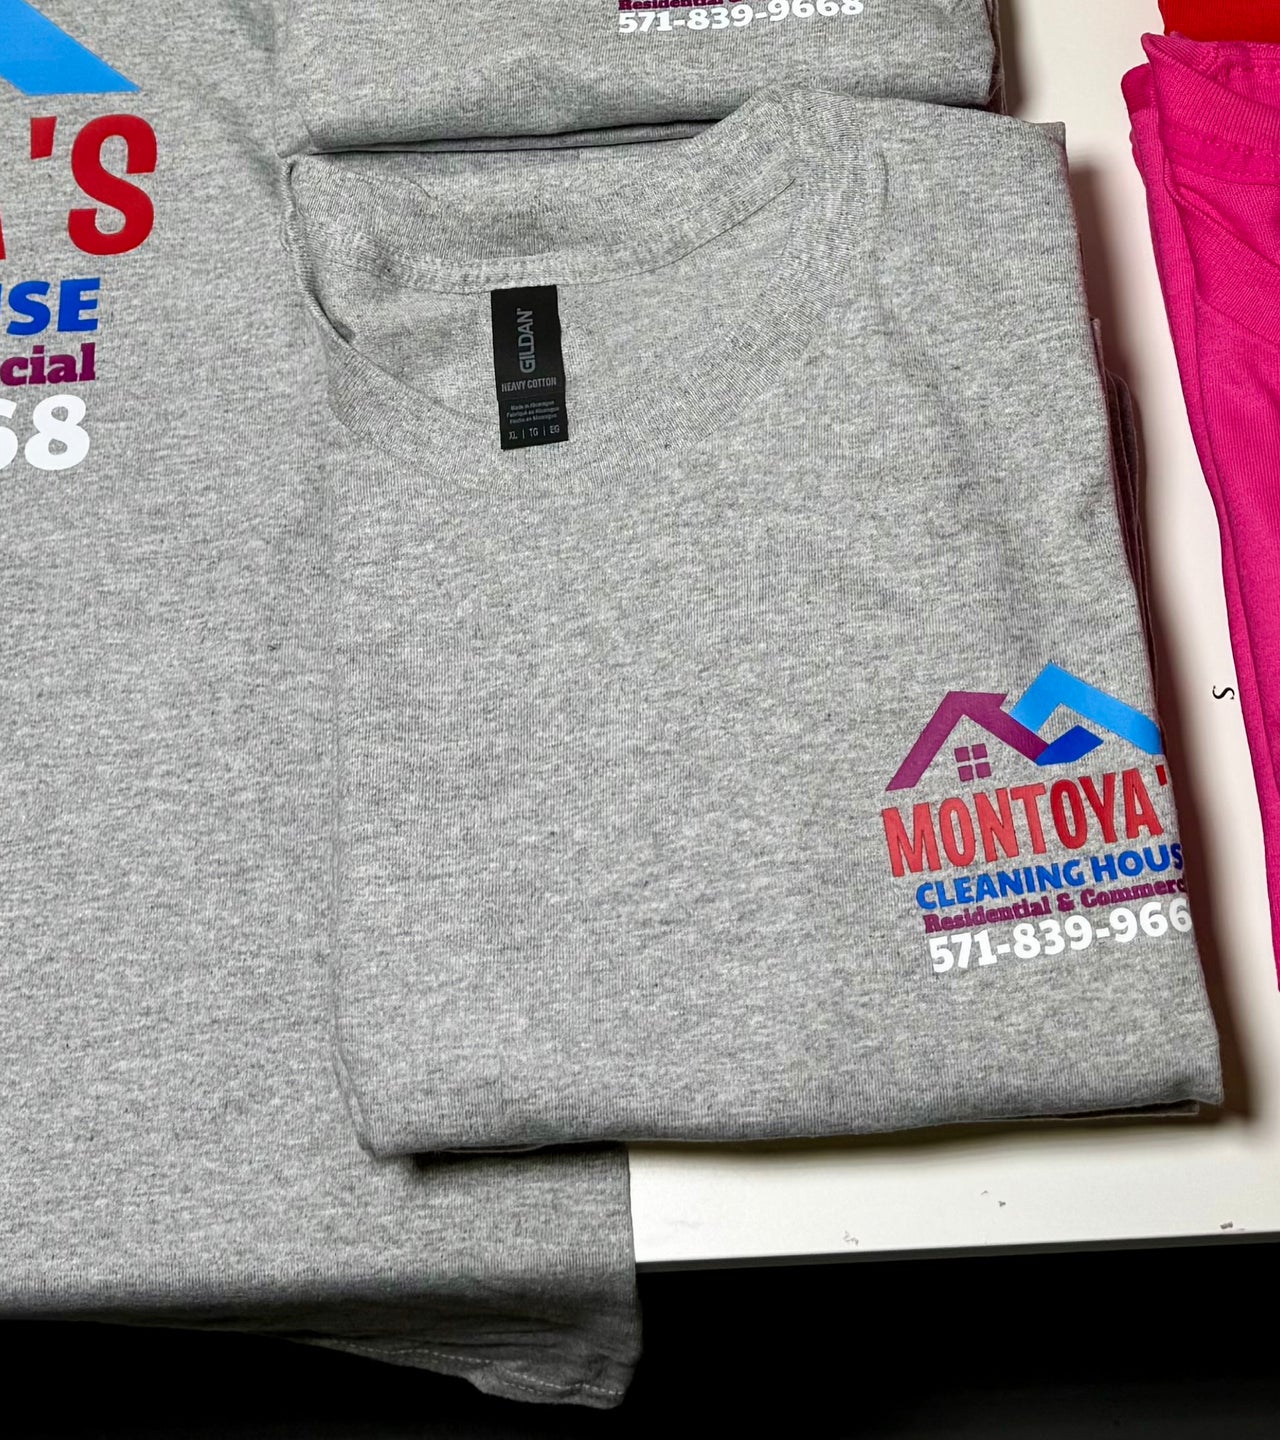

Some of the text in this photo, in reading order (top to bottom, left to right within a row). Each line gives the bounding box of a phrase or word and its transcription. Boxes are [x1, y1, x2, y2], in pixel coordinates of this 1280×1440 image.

[517, 309, 536, 373] GILDAN
[501, 376, 557, 392] HEAVY COTTON
[915, 860, 1086, 910] CLEANING
[923, 896, 1052, 933] Residential
[1057, 892, 1075, 912] &
